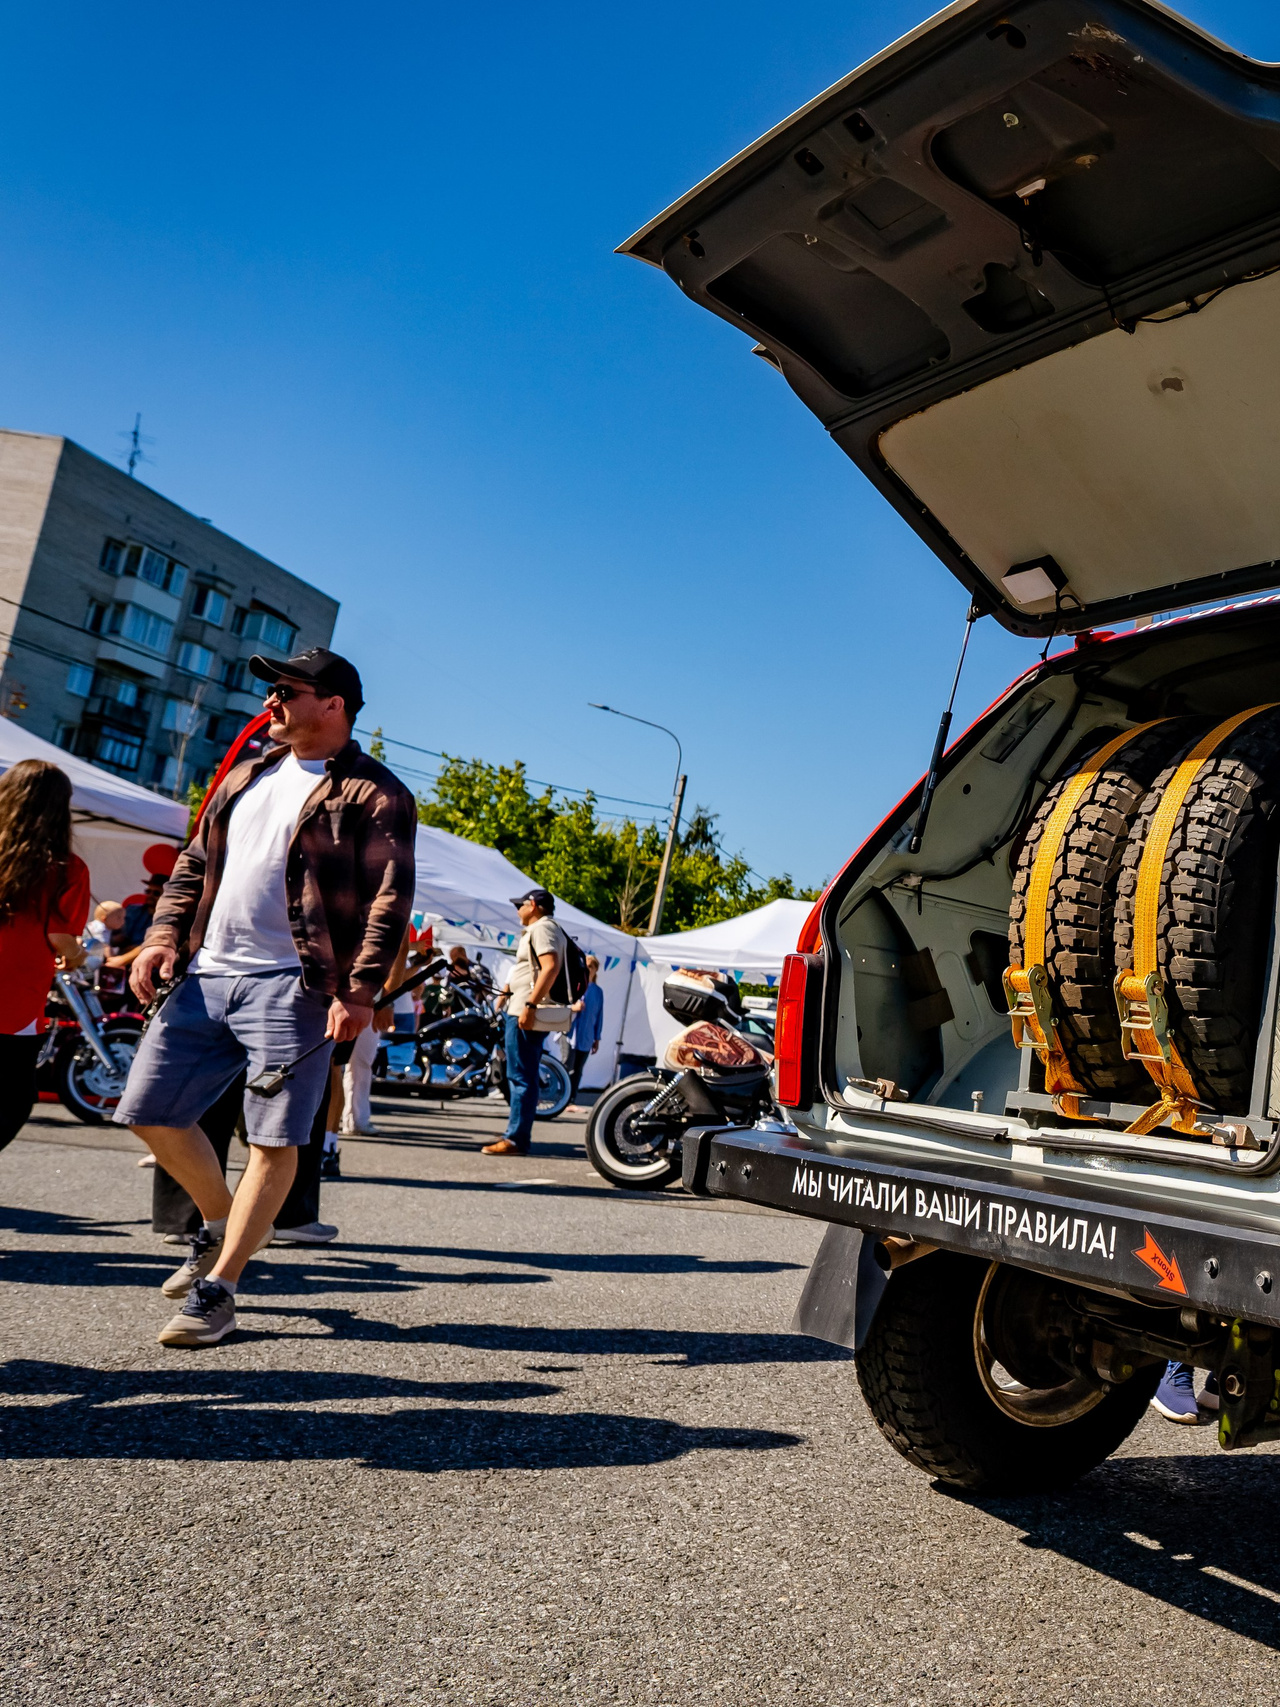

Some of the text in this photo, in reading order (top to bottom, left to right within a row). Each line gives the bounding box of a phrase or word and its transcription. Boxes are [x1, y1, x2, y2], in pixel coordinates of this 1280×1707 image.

[792, 1166, 1117, 1260] МЫ ЧИТАЛИ ВАШИ ПРАВИЛА!
